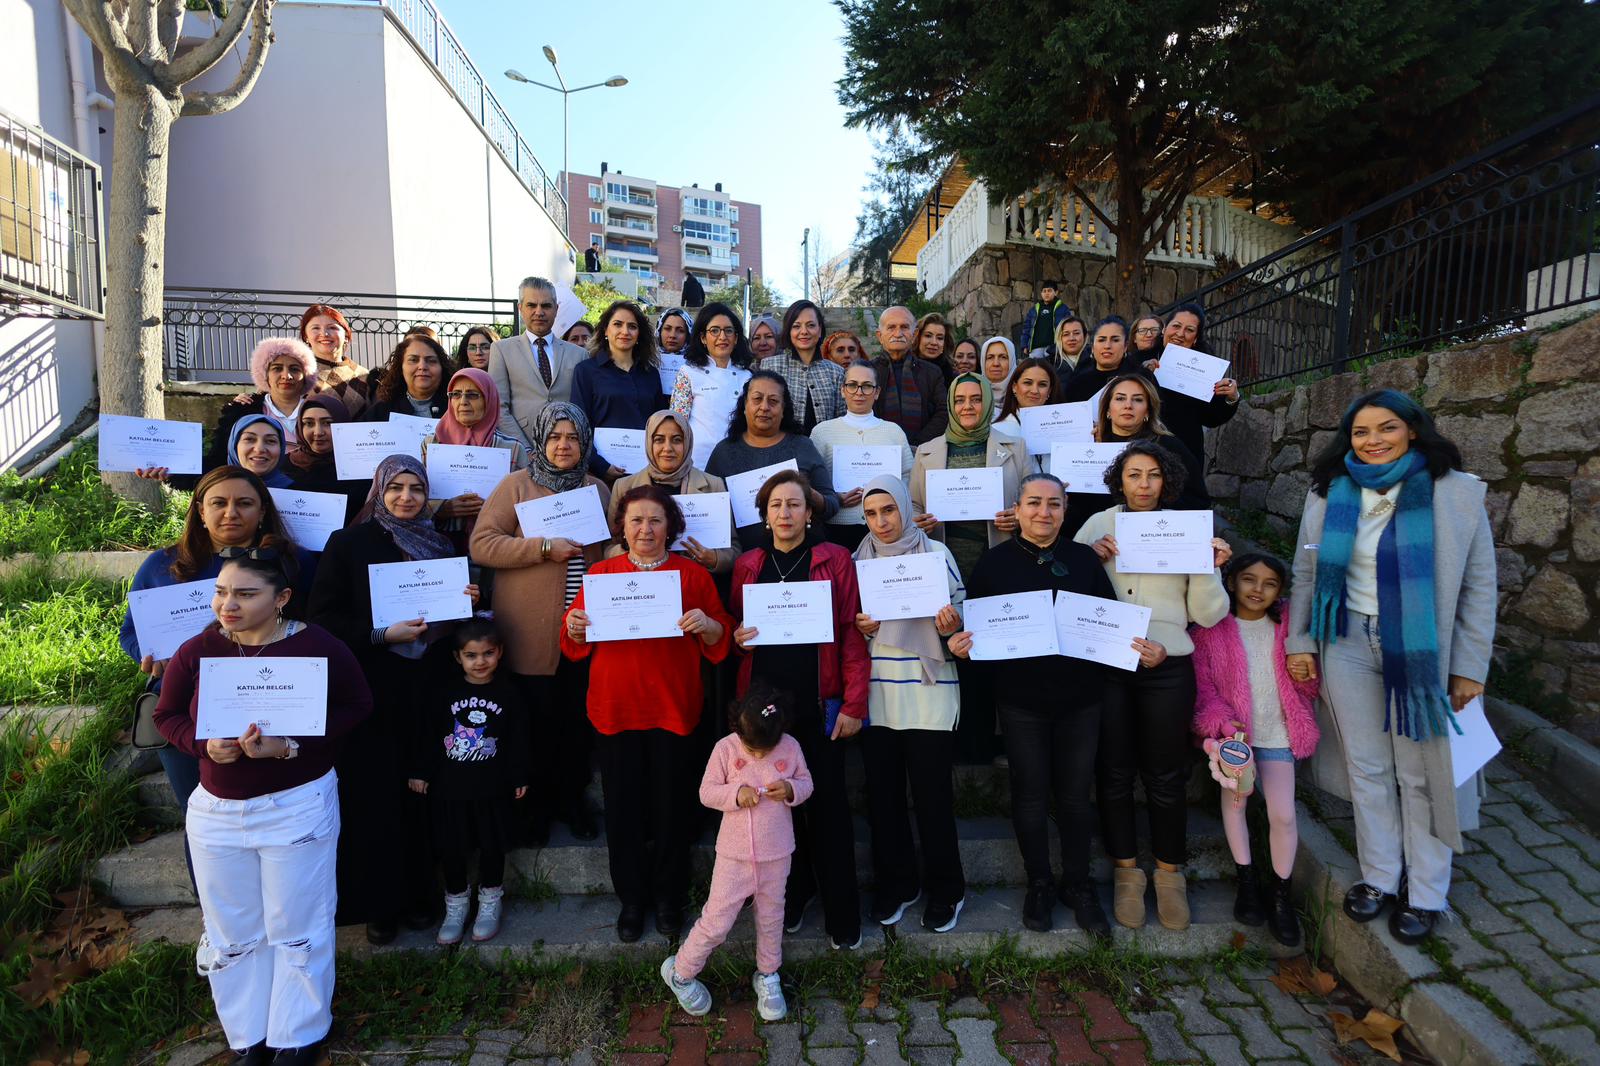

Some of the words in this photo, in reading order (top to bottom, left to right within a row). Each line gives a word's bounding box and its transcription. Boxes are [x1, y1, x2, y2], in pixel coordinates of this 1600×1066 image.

[543, 513, 562, 523] KATILIM
[421, 579, 444, 587] BELGESİ
[633, 593, 656, 601] BELGESİ
[170, 605, 199, 616] KATILIM
[987, 616, 1009, 624] KATILIM
[1008, 613, 1030, 621] BELGESİ
[1077, 616, 1098, 625] KATILIM
[1097, 620, 1121, 629] BELGESİ
[266, 683, 294, 691] BELGESİ
[450, 696, 503, 715] KUROMI
